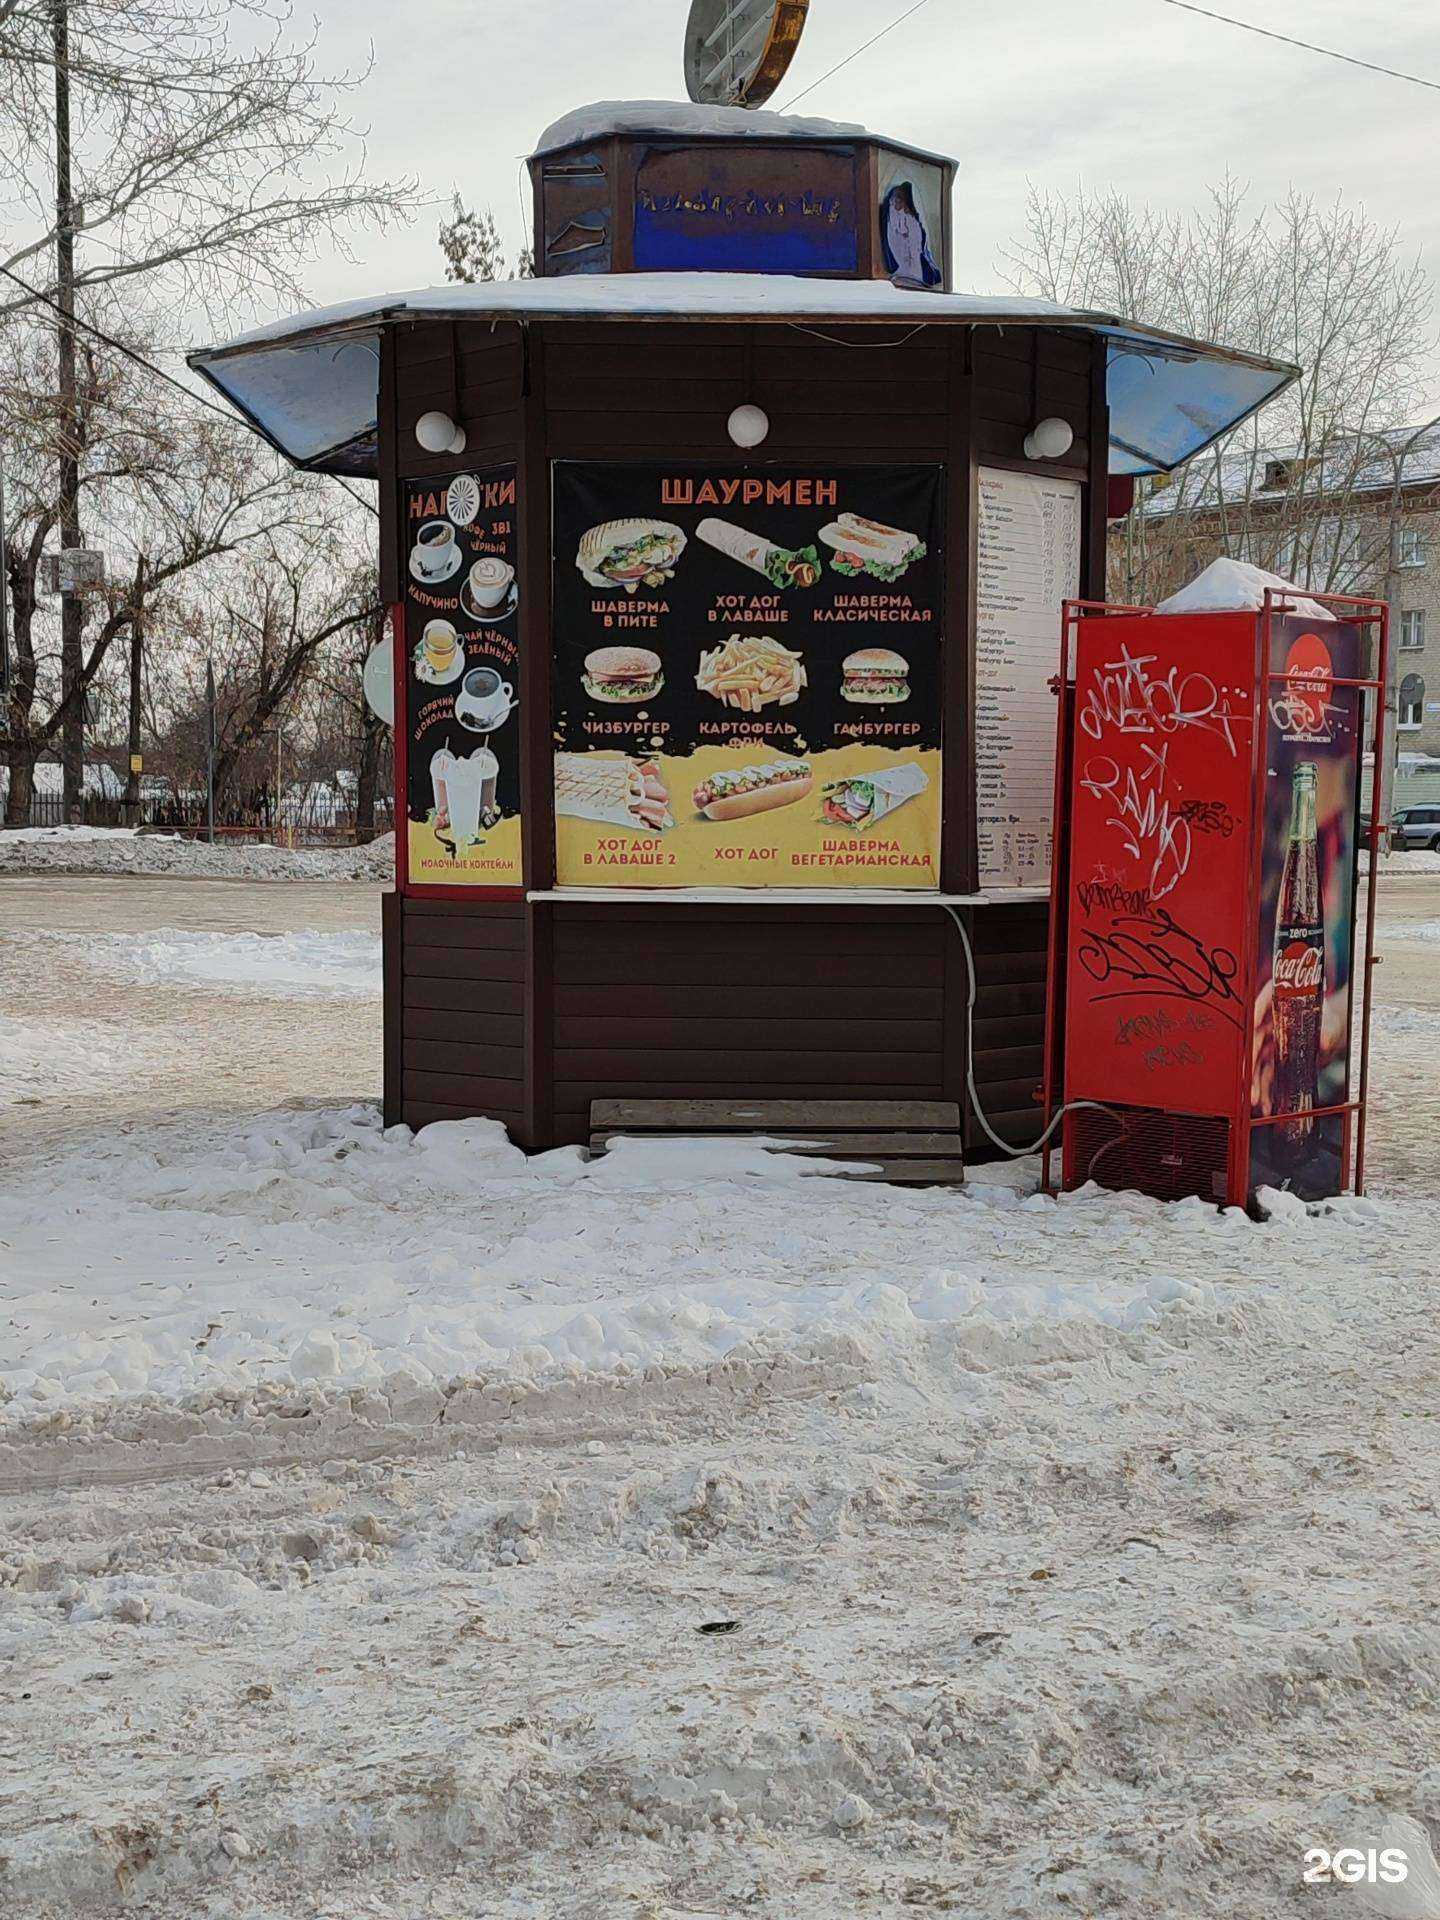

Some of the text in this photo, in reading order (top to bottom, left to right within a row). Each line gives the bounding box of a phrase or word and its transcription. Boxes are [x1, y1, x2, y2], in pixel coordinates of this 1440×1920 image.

[661, 478, 837, 505] ШАУРМЕН
[407, 583, 459, 610] КАПУЧИНО
[715, 595, 781, 608] ХОТ ДОГ
[833, 595, 913, 608] ШАВЕРМА
[591, 600, 670, 613] ШАВЕРМА
[603, 615, 658, 627] В ПИТЕ
[708, 610, 789, 622] В ЛАВАШЕ
[813, 609, 932, 622] КЛАСИЧЕСКАЯ
[464, 628, 483, 641] ЧАЙ
[418, 694, 454, 719] ГОРЯЧИЙ
[414, 709, 454, 740] ШОКОЛАД
[582, 721, 670, 734] ЧИЗБУРГЕР
[699, 721, 794, 734] КАРТОФЕЛЬ
[833, 723, 921, 735] ГАМБУРГЕР
[597, 839, 663, 851] ХОТ ДОГ
[822, 840, 901, 852] ШАВЕРМА
[583, 853, 677, 865] В ЛАВАШЕ 2
[714, 848, 779, 860] ХОТ ДОГ
[791, 853, 931, 866] ВЕГЕТАРИАНСКАЯ
[1289, 928, 1308, 938] zero
